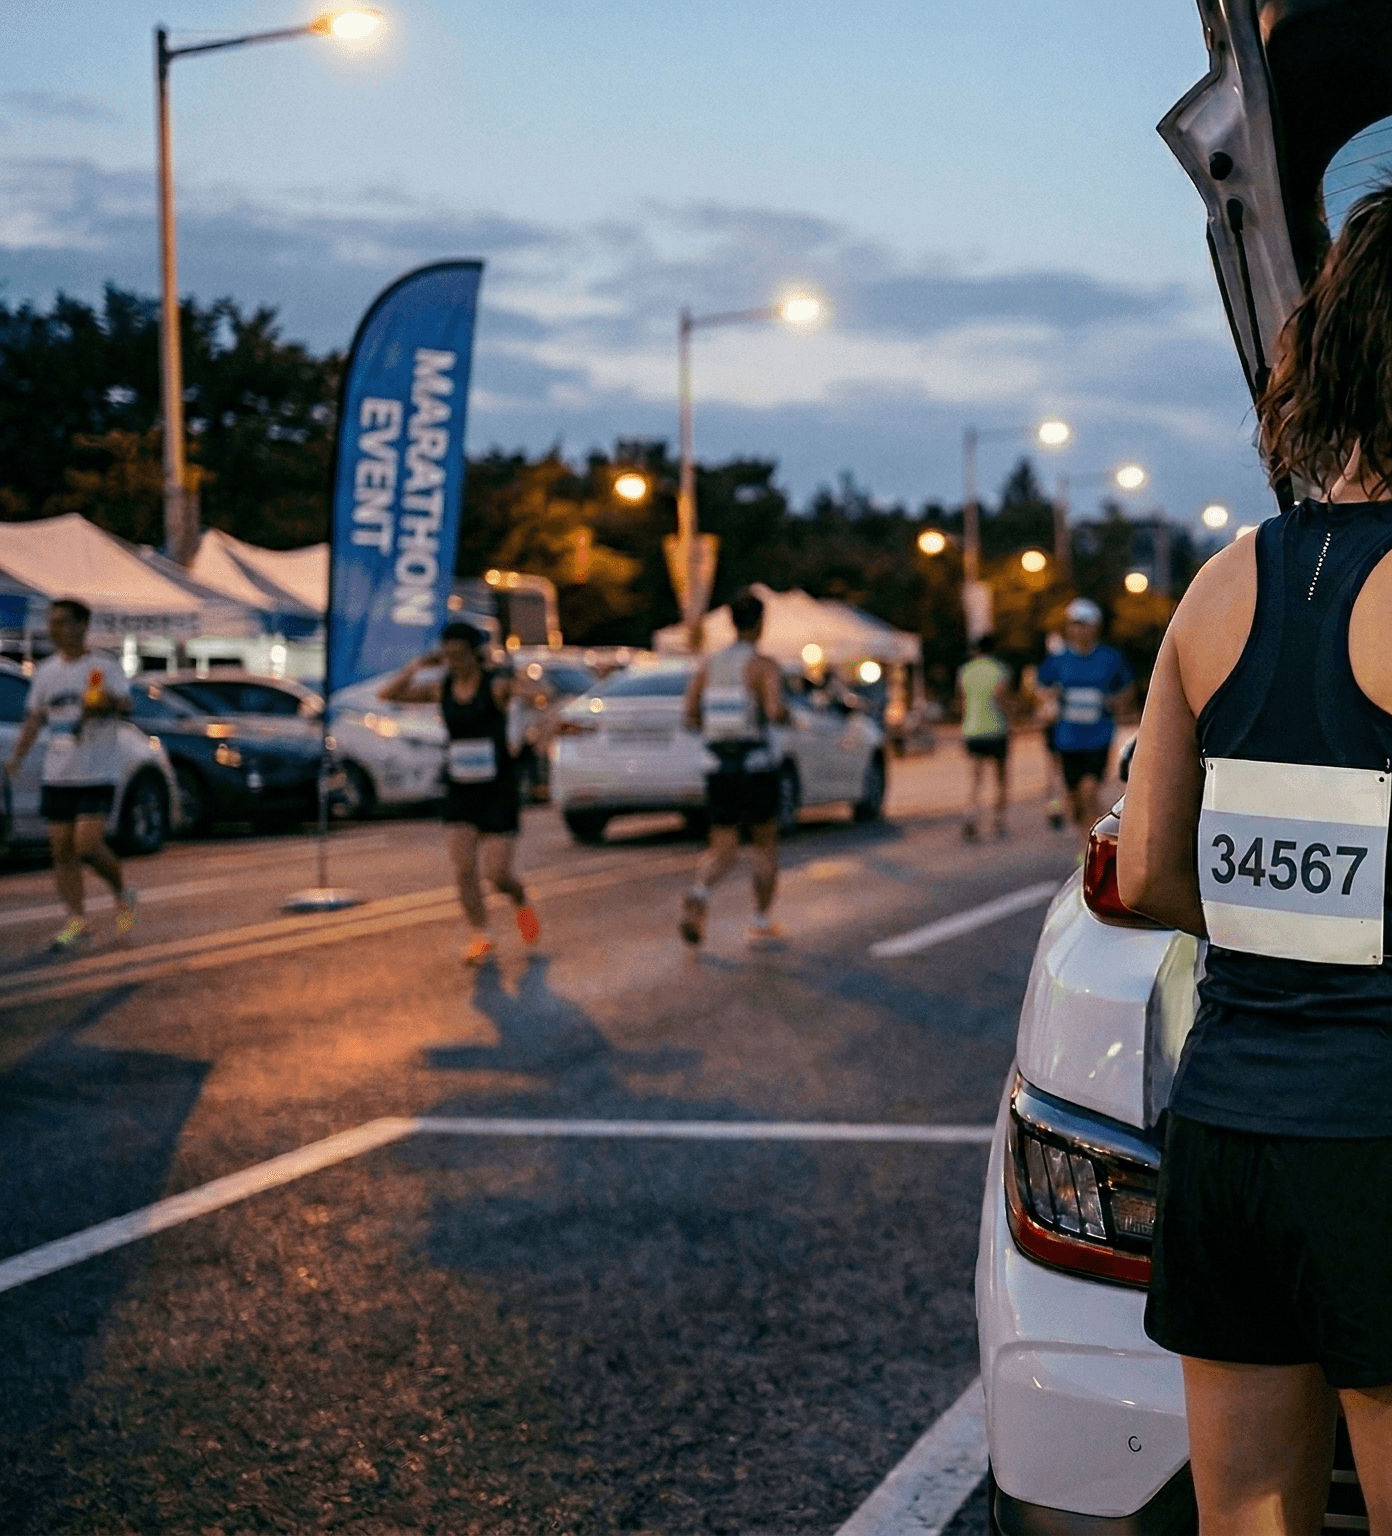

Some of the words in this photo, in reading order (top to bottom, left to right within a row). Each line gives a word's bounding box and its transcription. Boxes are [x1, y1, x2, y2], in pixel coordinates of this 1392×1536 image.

[351, 397, 402, 556] EVENT
[391, 347, 457, 626] MARATHON
[1211, 834, 1368, 895] 34567
